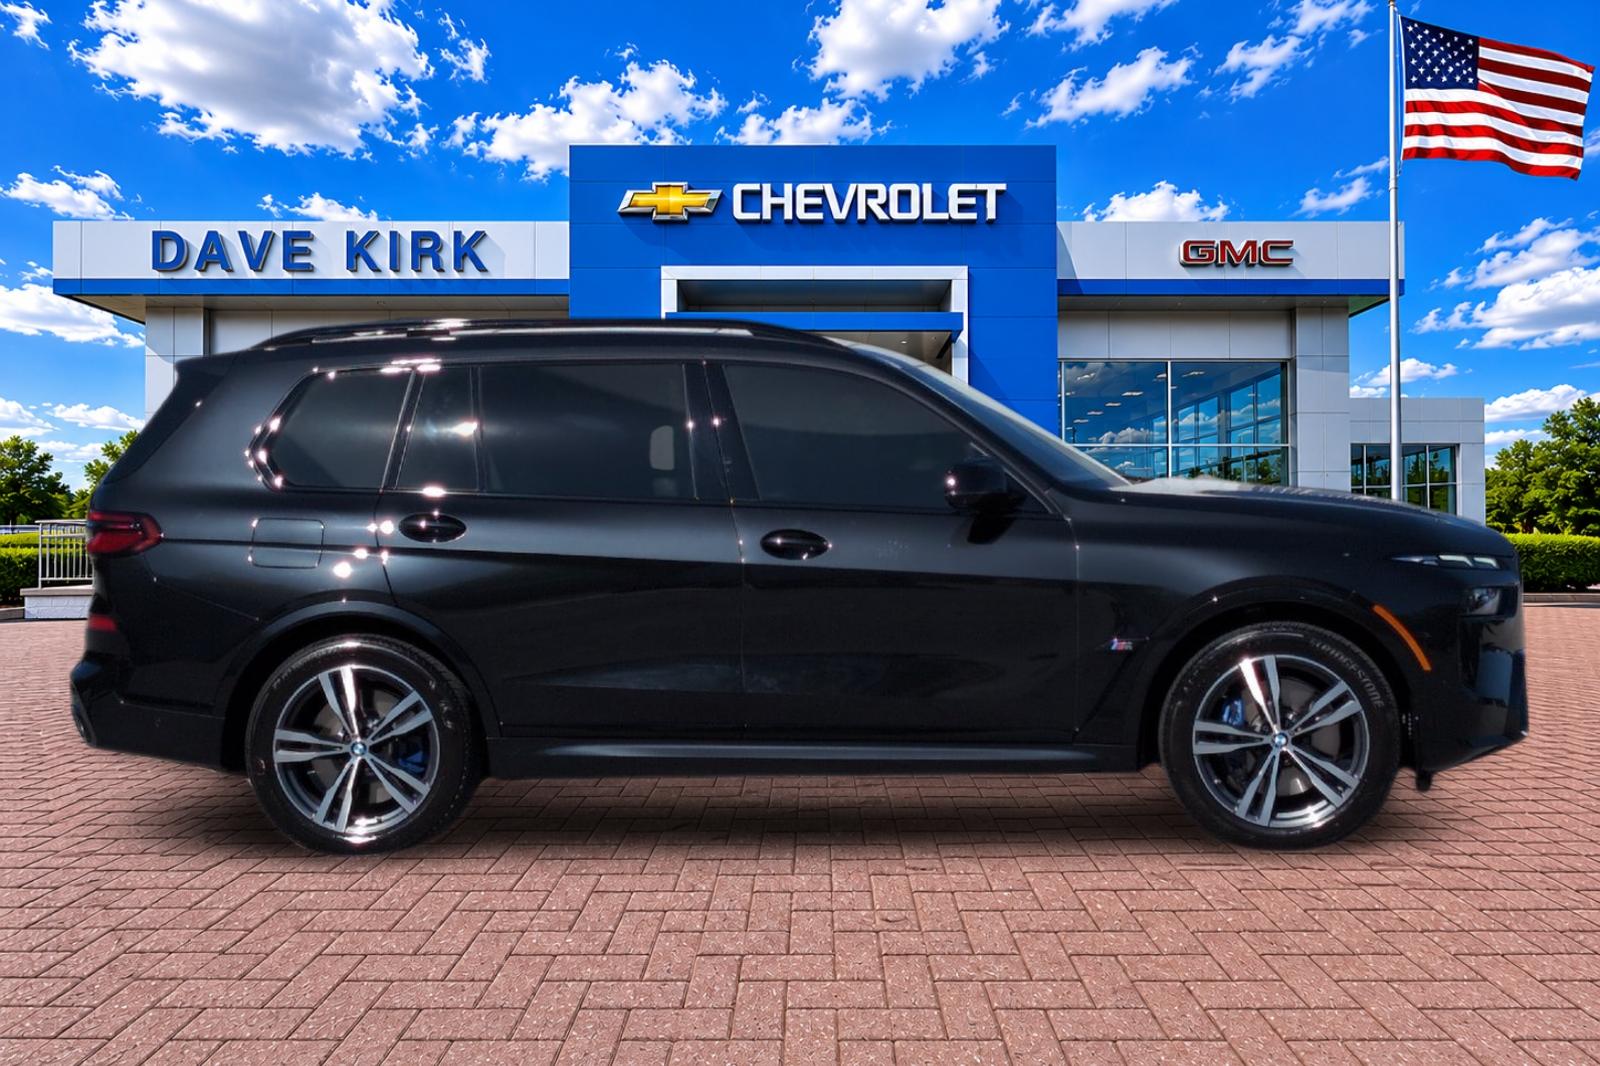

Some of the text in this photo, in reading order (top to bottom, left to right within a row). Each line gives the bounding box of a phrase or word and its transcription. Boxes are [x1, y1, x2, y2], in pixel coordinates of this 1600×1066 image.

[732, 182, 1007, 222] CHEVROLET
[151, 230, 489, 273] DAVE KIRK
[1179, 239, 1294, 267] GMC
